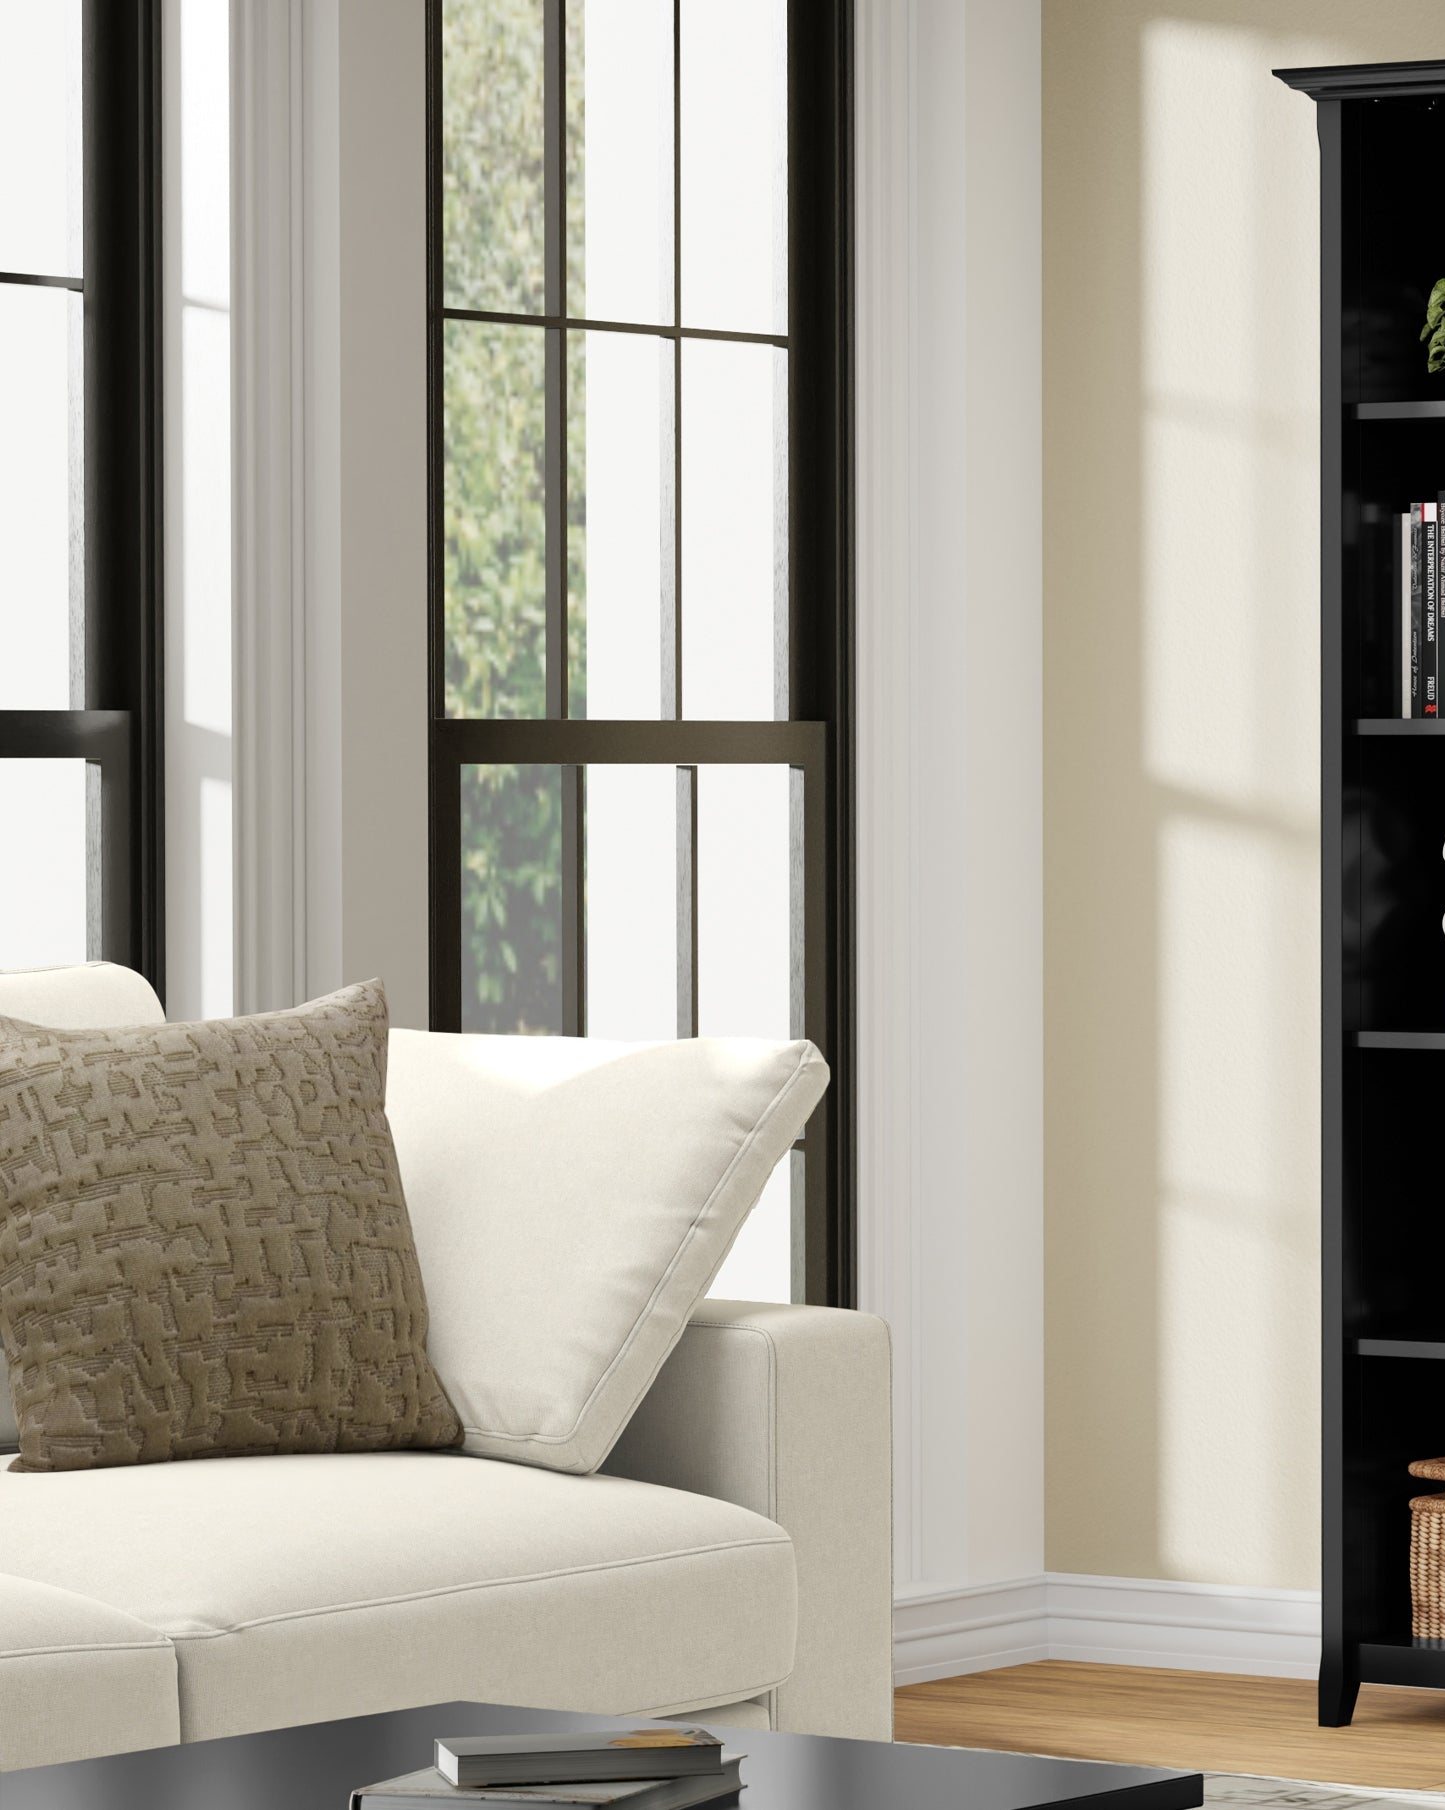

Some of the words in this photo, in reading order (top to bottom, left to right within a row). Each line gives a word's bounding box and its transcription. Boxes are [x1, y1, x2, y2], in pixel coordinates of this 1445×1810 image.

[1427, 524, 1435, 539] THE
[1427, 540, 1435, 599] INTERPRETATION
[1427, 600, 1435, 611] OF
[1427, 612, 1435, 641] DREAMS
[1427, 676, 1435, 700] FREUD
